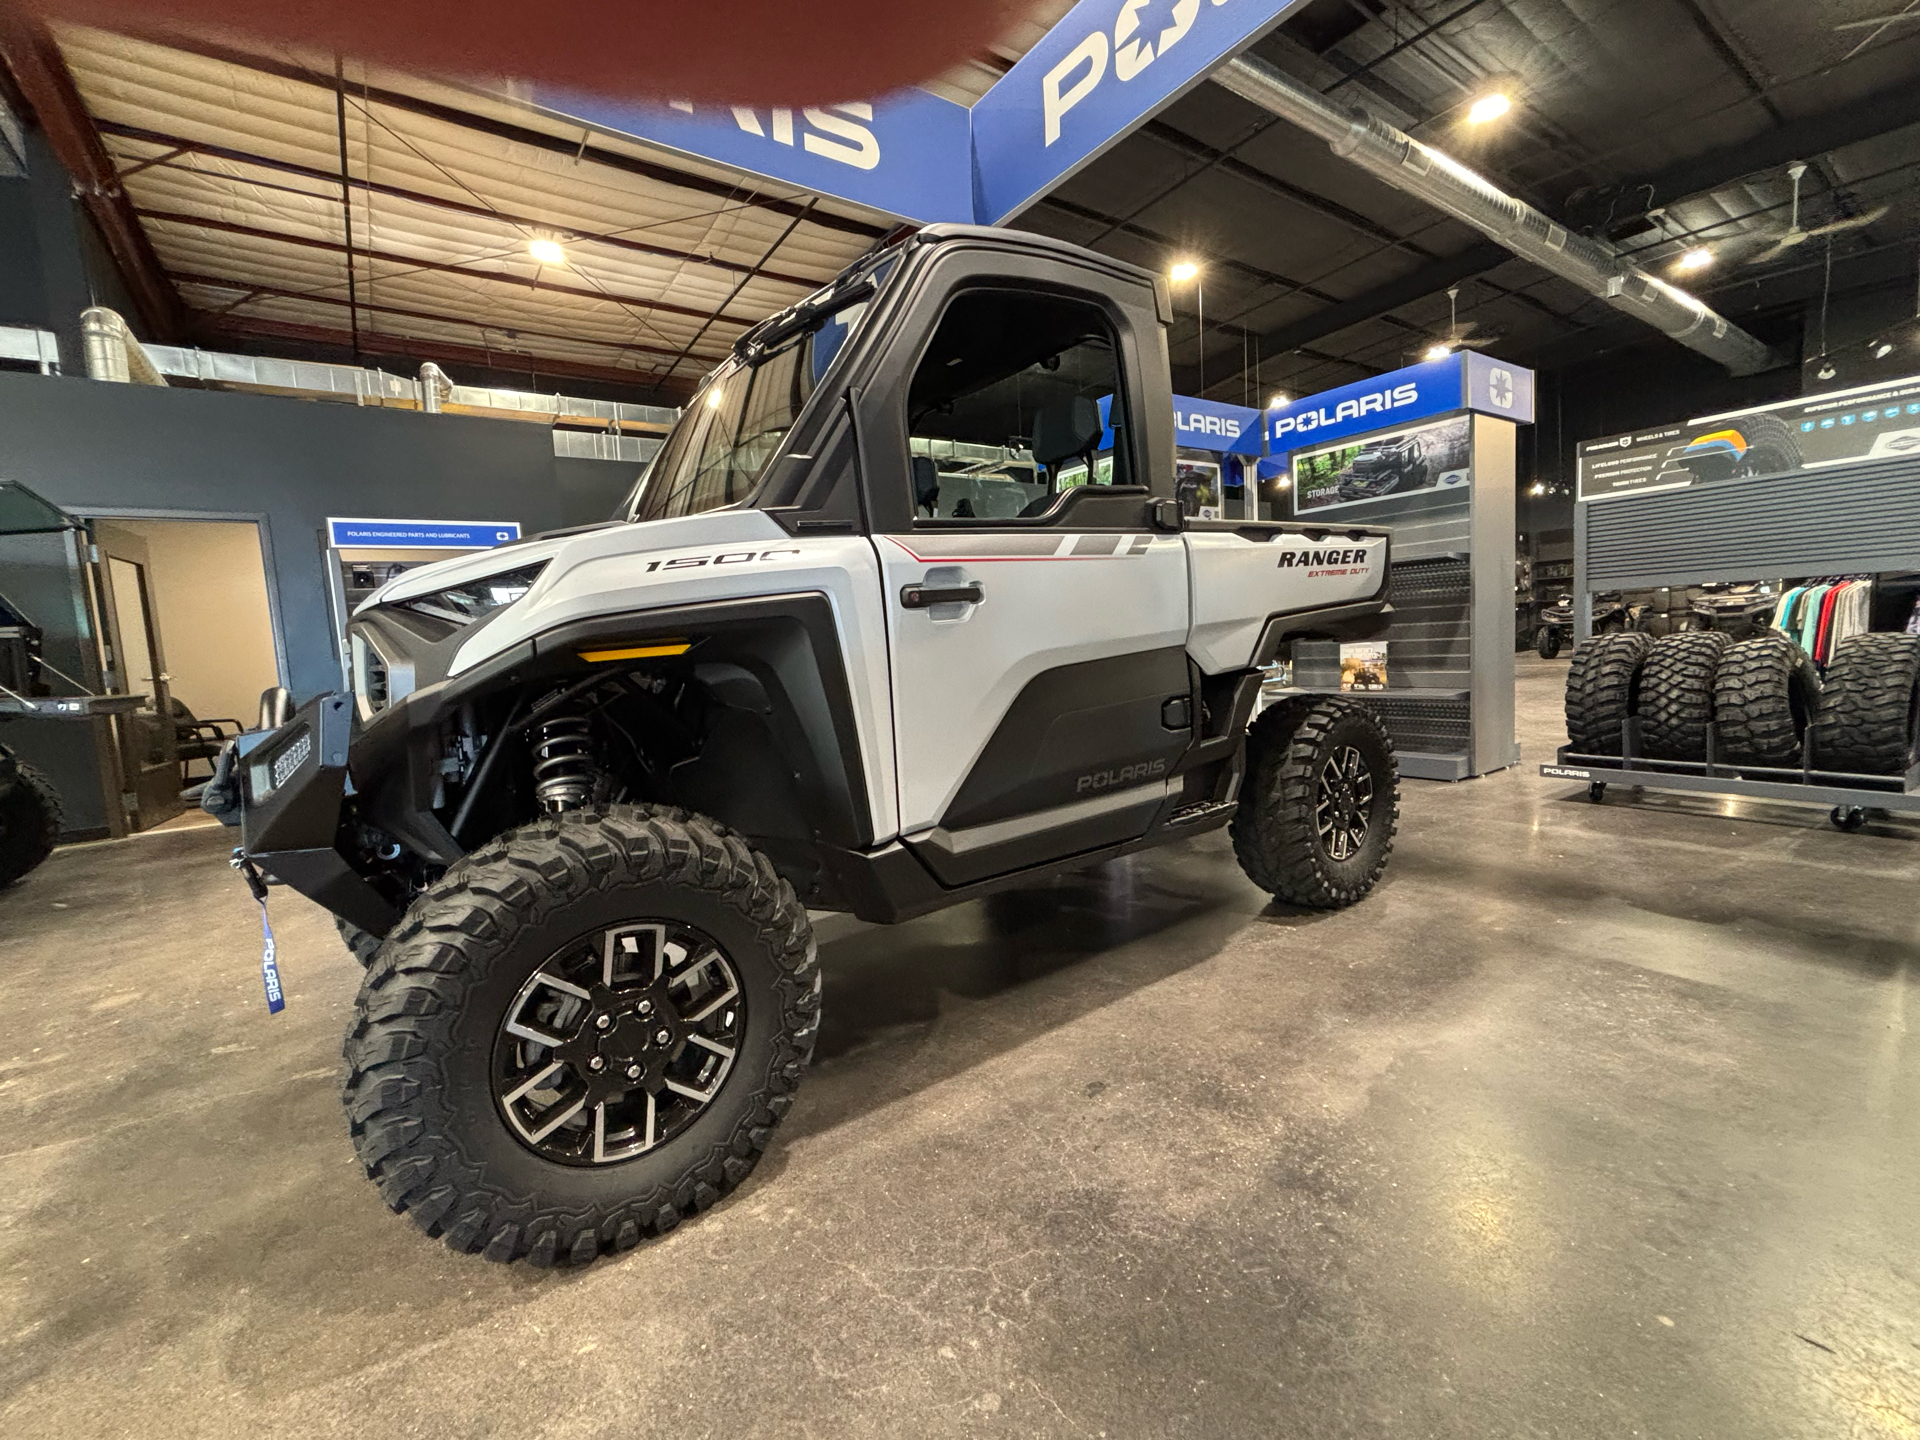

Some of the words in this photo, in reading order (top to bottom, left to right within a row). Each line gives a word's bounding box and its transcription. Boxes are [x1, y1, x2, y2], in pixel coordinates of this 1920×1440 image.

[1042, 0, 1229, 148] PO
[1275, 382, 1418, 438] POLARIS
[1174, 411, 1241, 438] LARIS
[1307, 485, 1340, 499] STORAGE
[1277, 549, 1367, 568] RANGER
[1307, 569, 1348, 577] EXTREME
[1076, 758, 1166, 793] POLARIS
[1543, 768, 1590, 777] POLARIS
[264, 938, 281, 1002] POLARIS
